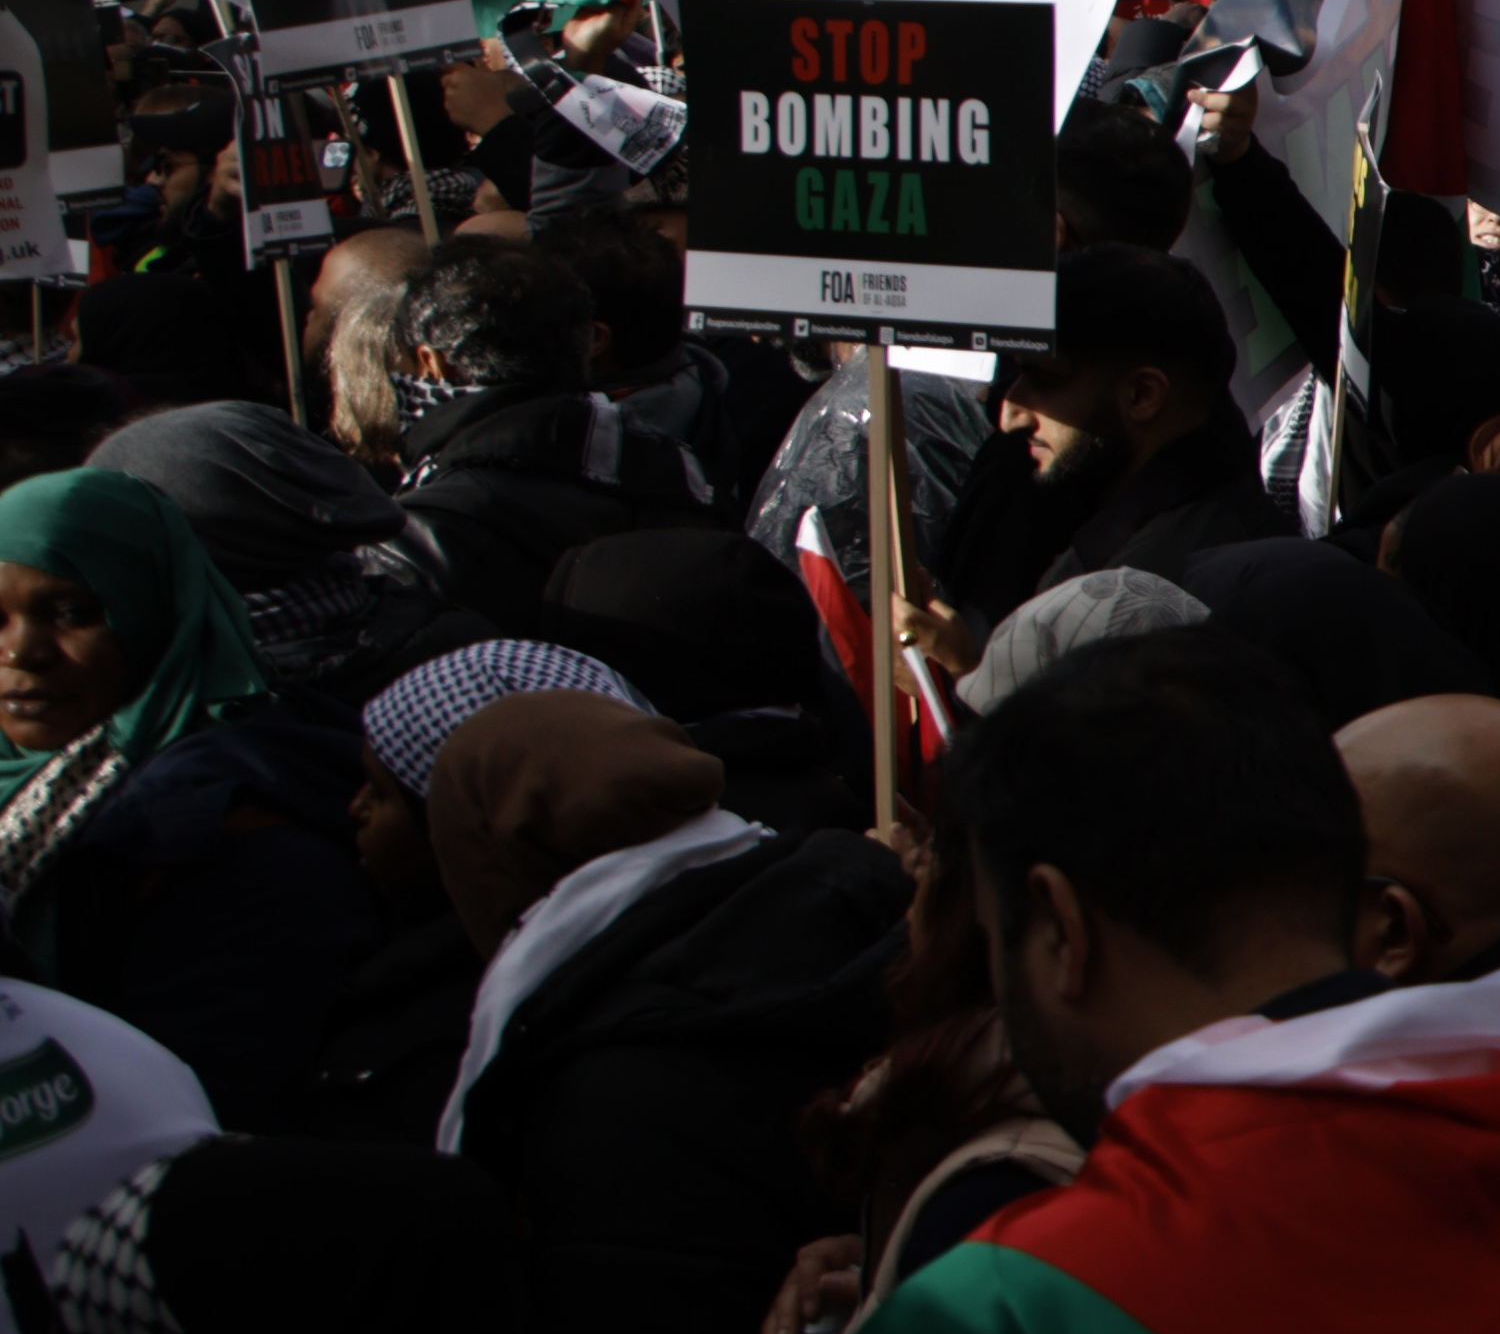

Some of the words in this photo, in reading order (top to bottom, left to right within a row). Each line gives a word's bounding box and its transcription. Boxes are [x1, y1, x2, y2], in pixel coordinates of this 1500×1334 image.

[789, 16, 927, 86] STOP
[738, 89, 992, 166] BOMBING
[795, 166, 928, 236] GAZA
[821, 270, 856, 304] FOA
[862, 273, 907, 292] FRIENDS
